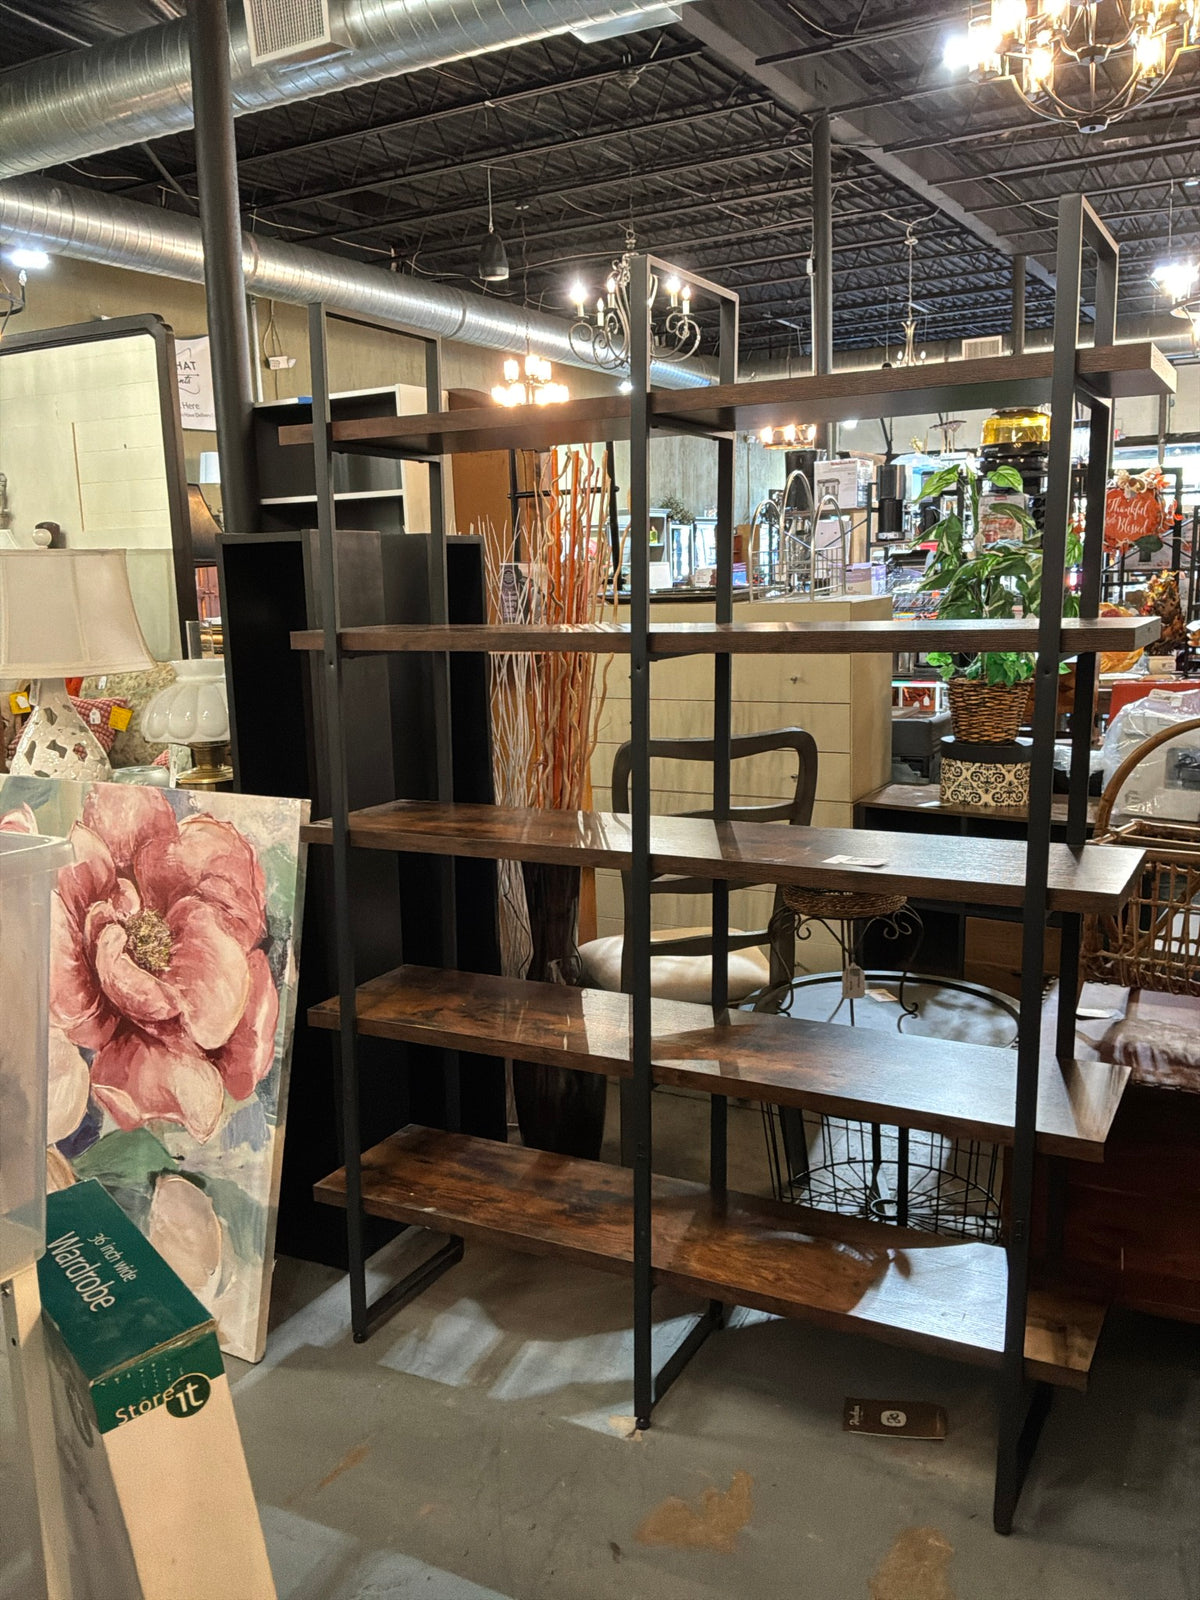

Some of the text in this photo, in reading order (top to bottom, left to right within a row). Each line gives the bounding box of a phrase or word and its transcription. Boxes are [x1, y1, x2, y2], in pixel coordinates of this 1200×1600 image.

[182, 401, 200, 410] Here
[1107, 497, 1151, 520] Thankful
[1117, 516, 1149, 534] Blessed
[47, 1230, 116, 1312] Wardrobe
[87, 1232, 138, 1283] 36 inch wide
[115, 1382, 204, 1426] Store it
